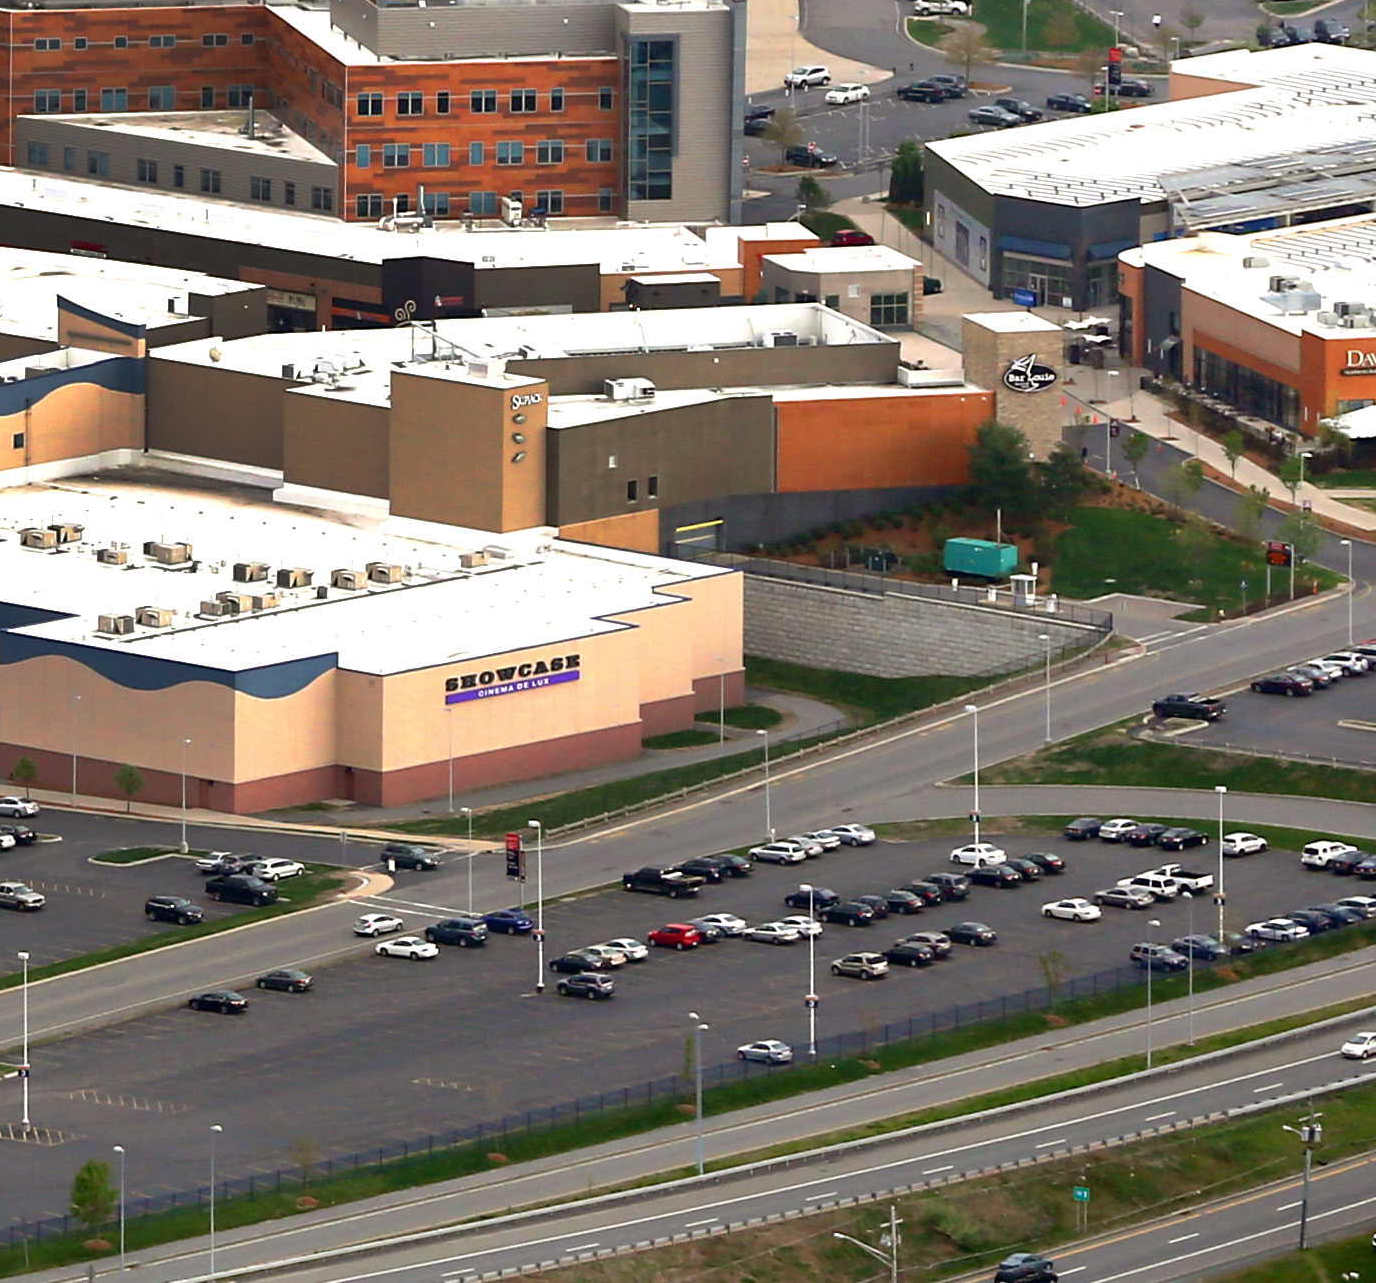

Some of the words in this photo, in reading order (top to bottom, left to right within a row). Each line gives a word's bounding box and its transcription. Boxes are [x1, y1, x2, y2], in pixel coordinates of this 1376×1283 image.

[1008, 373, 1026, 383] Bar
[445, 654, 581, 692] SHOWCASE
[478, 685, 514, 698] CINEMA
[516, 681, 529, 690] DE
[532, 678, 550, 687] LUX
